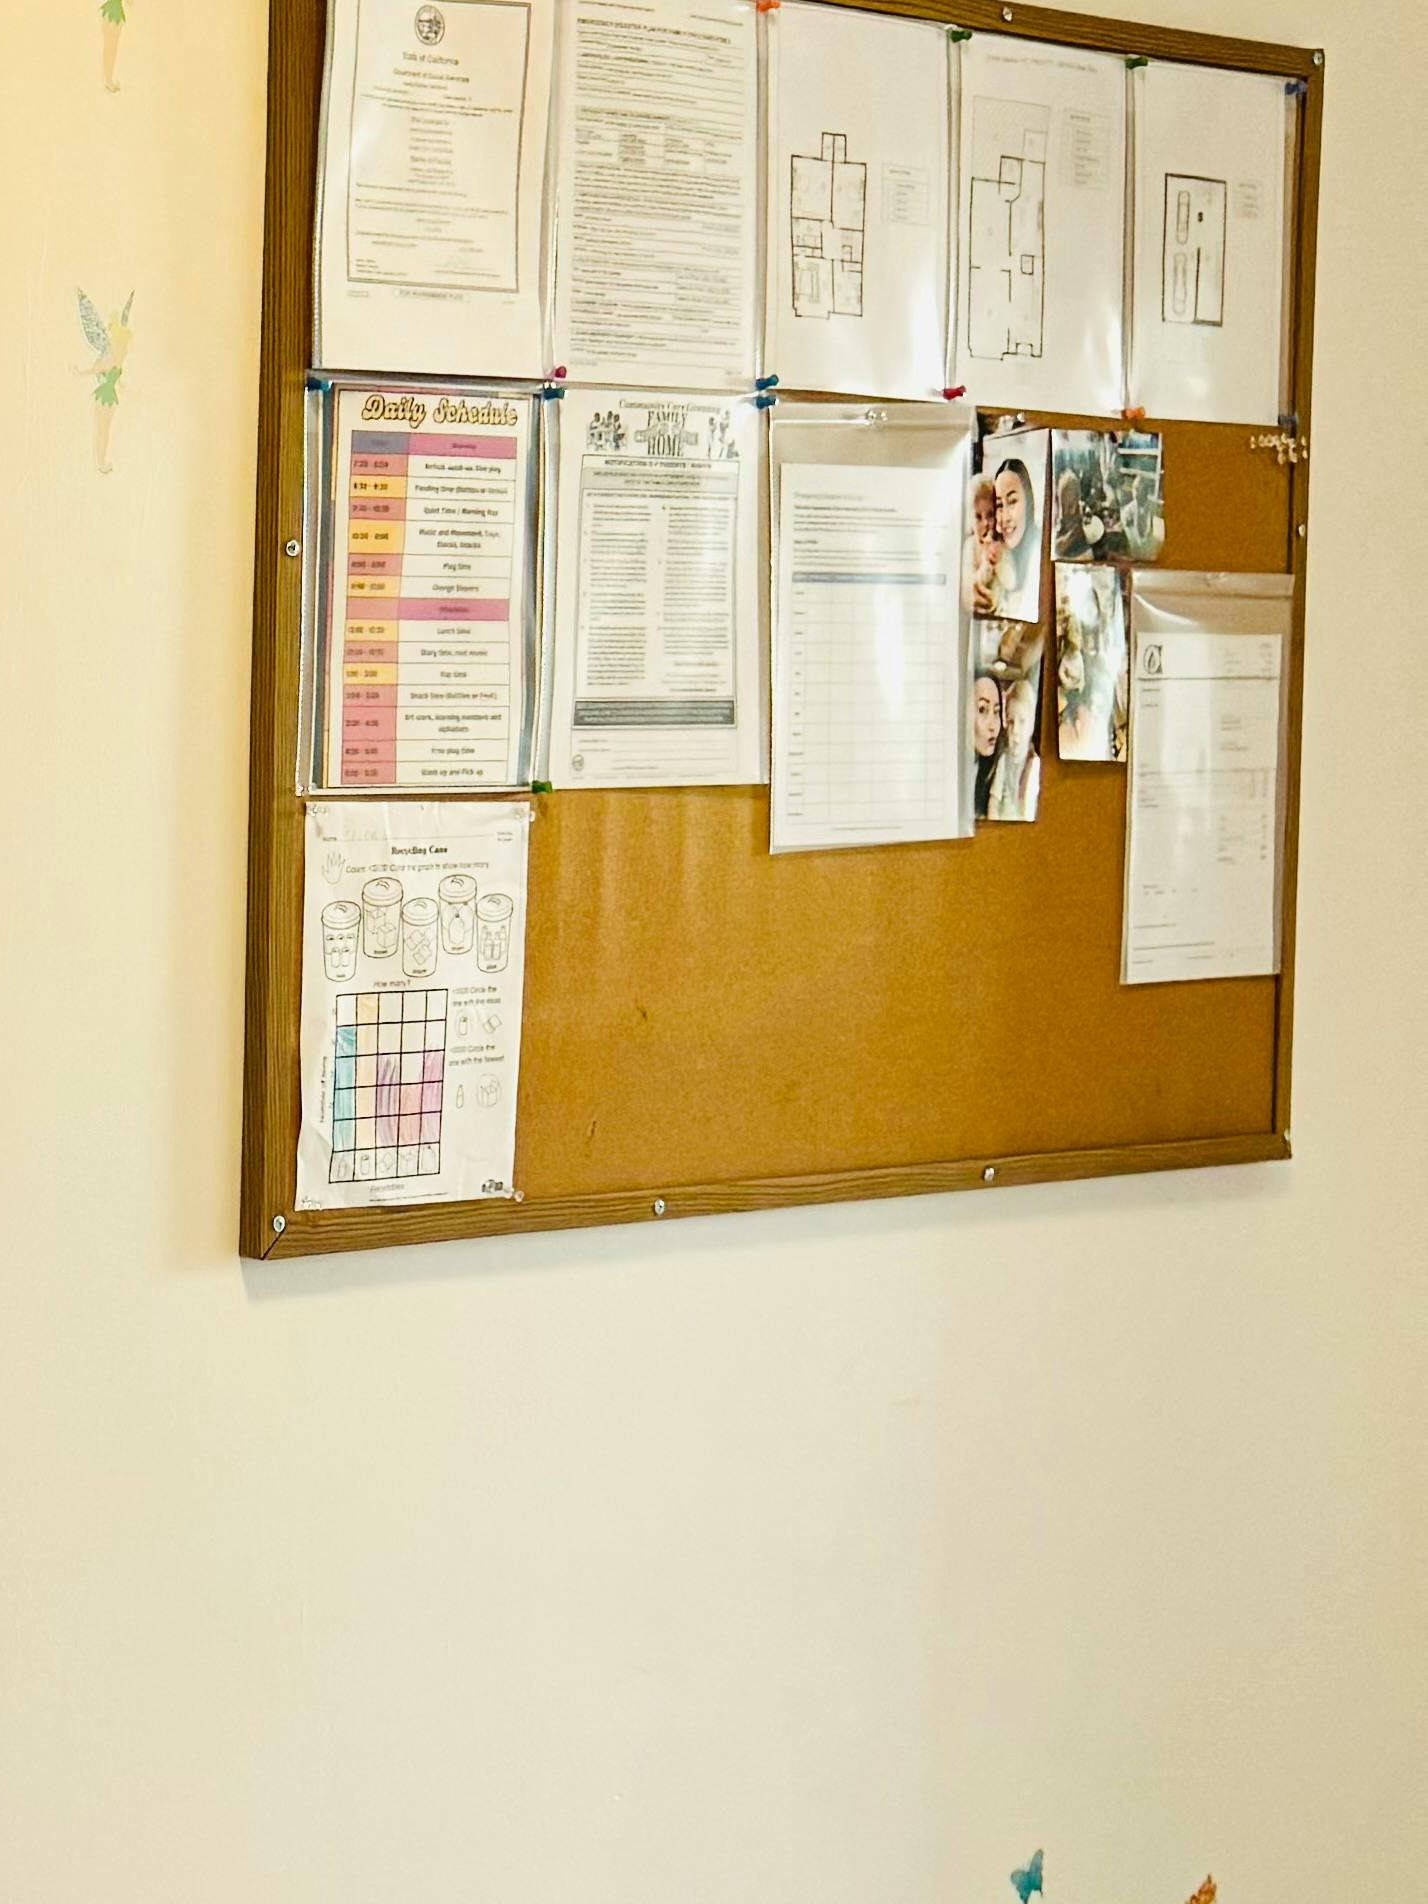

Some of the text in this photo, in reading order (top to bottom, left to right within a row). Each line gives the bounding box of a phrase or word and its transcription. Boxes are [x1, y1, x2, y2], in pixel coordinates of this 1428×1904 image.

[362, 394, 518, 429] Daily Schedule
[647, 410, 687, 427] FAMILY
[647, 434, 684, 457] HOME
